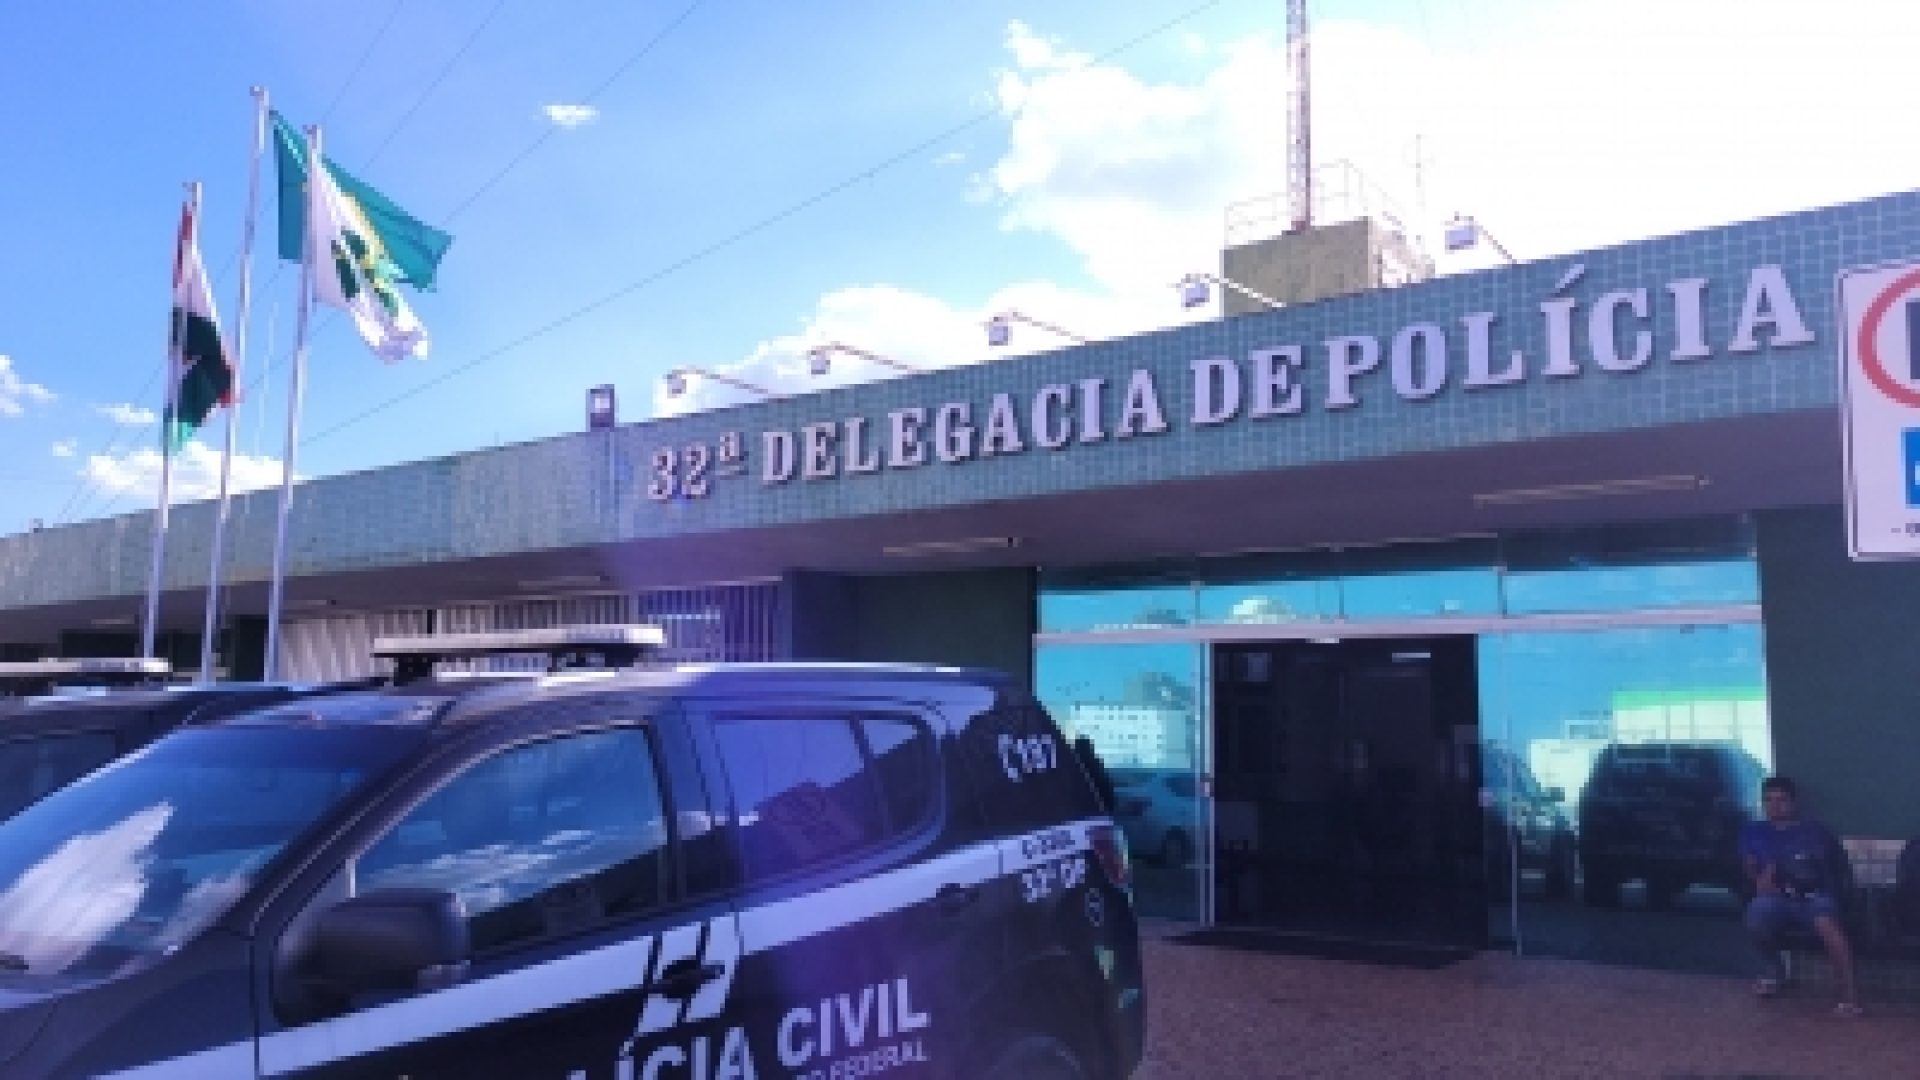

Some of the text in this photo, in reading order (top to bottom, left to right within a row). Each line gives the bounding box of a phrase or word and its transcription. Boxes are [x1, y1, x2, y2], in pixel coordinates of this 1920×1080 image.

[762, 368, 1168, 482] DELEGACIA
[1190, 345, 1302, 426] DE
[1324, 264, 1815, 410] POLÍCIA
[777, 976, 931, 1069] CIVIL
